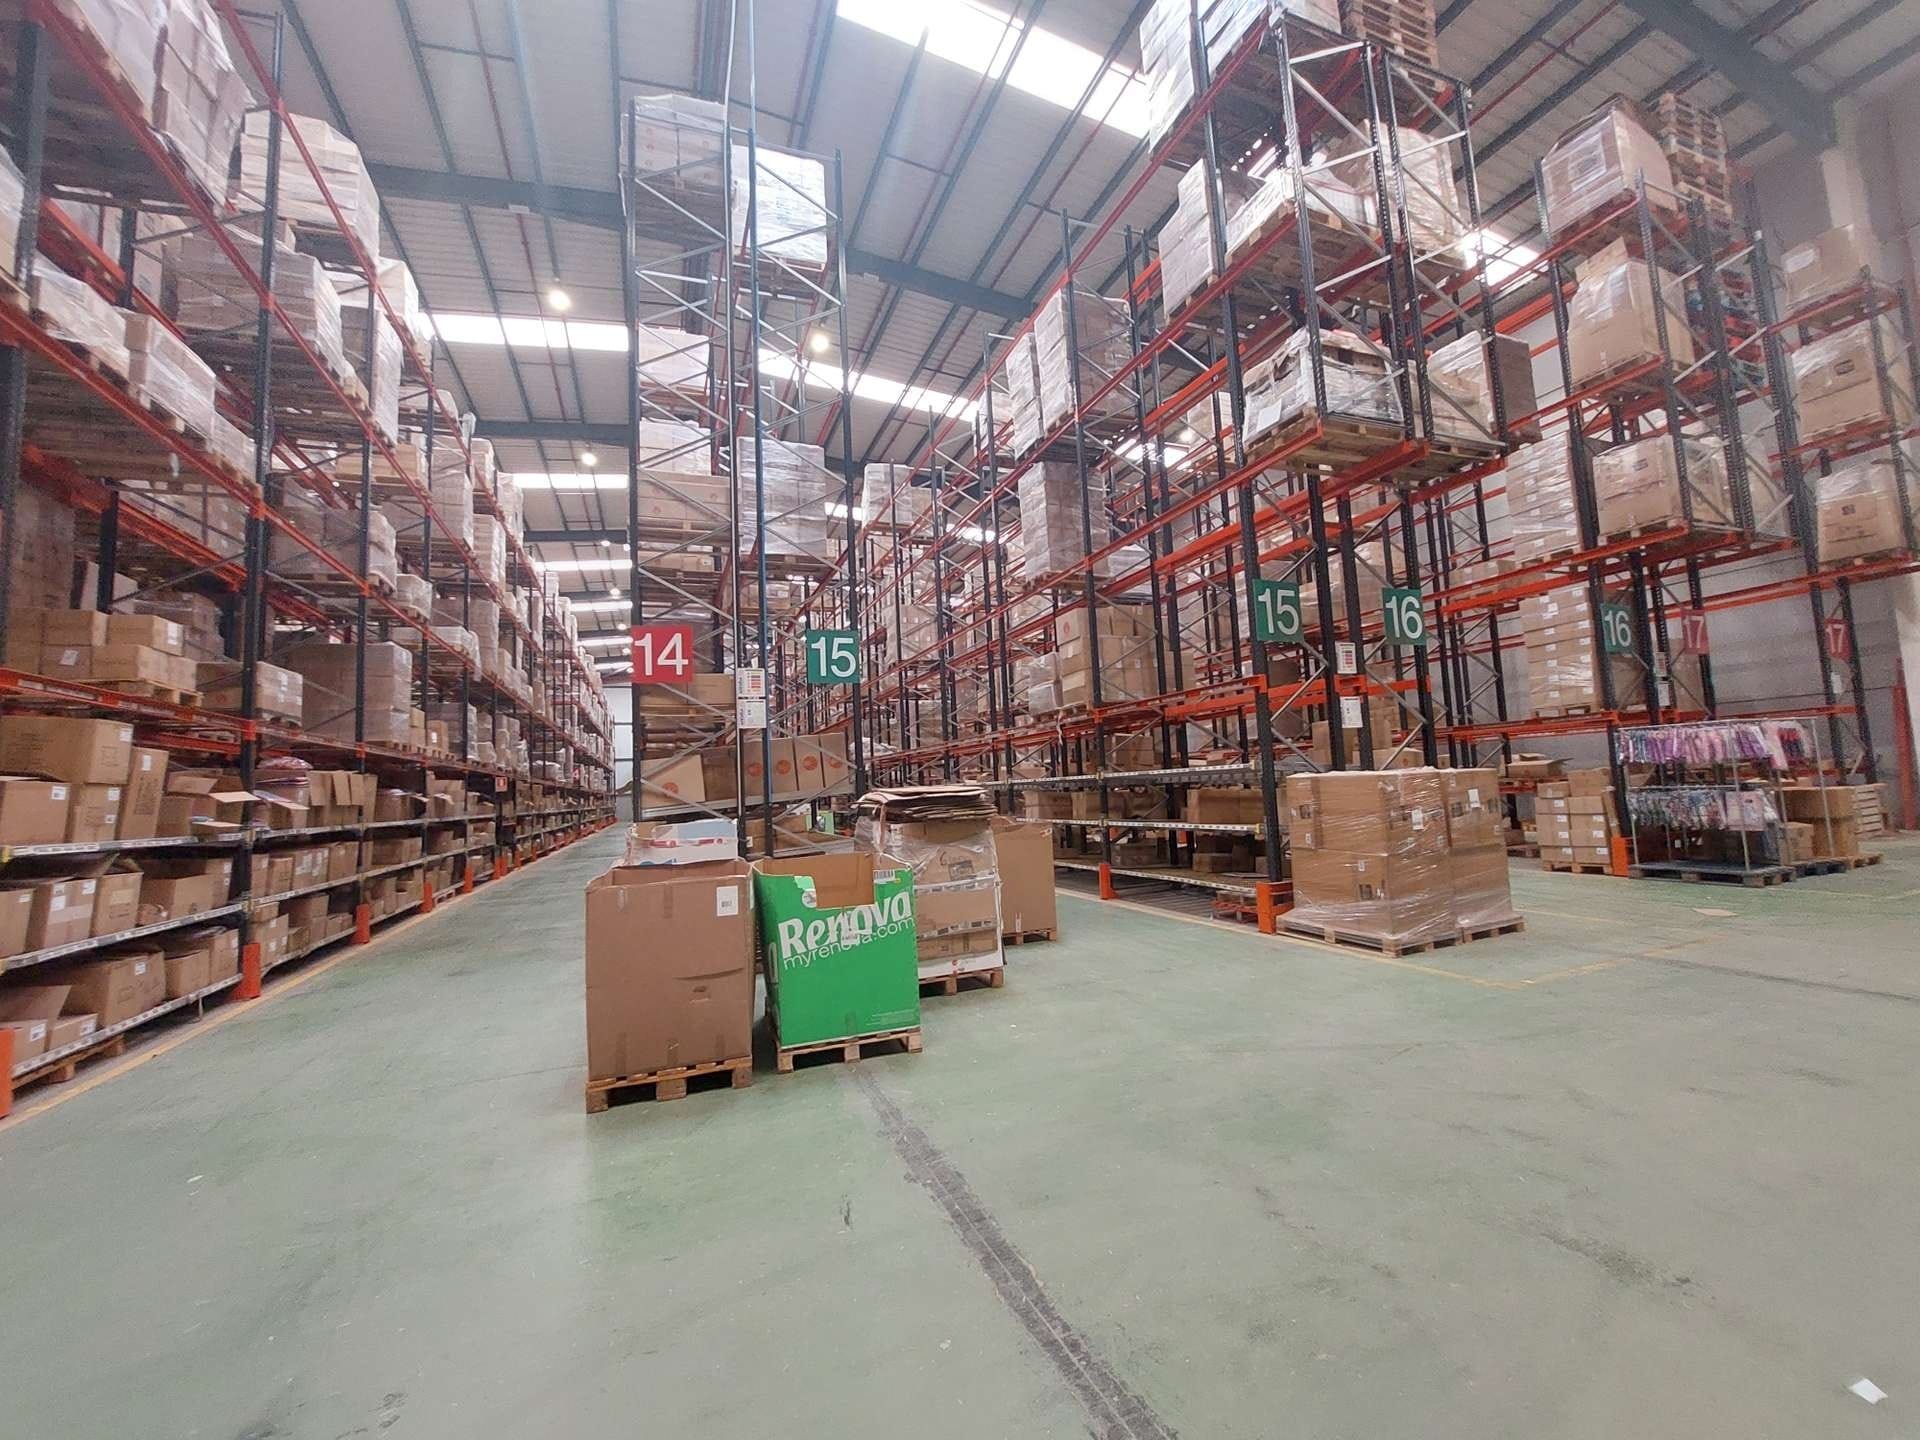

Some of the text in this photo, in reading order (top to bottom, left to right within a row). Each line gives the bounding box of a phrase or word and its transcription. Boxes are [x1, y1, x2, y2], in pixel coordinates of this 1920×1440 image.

[1258, 588, 1299, 635] 15
[1385, 595, 1423, 639] 16
[1604, 610, 1632, 647] 16
[1683, 615, 1704, 649] 17
[634, 632, 689, 676] 14
[811, 637, 856, 678] 15
[1825, 623, 1844, 654] 17
[778, 891, 912, 959] Renova
